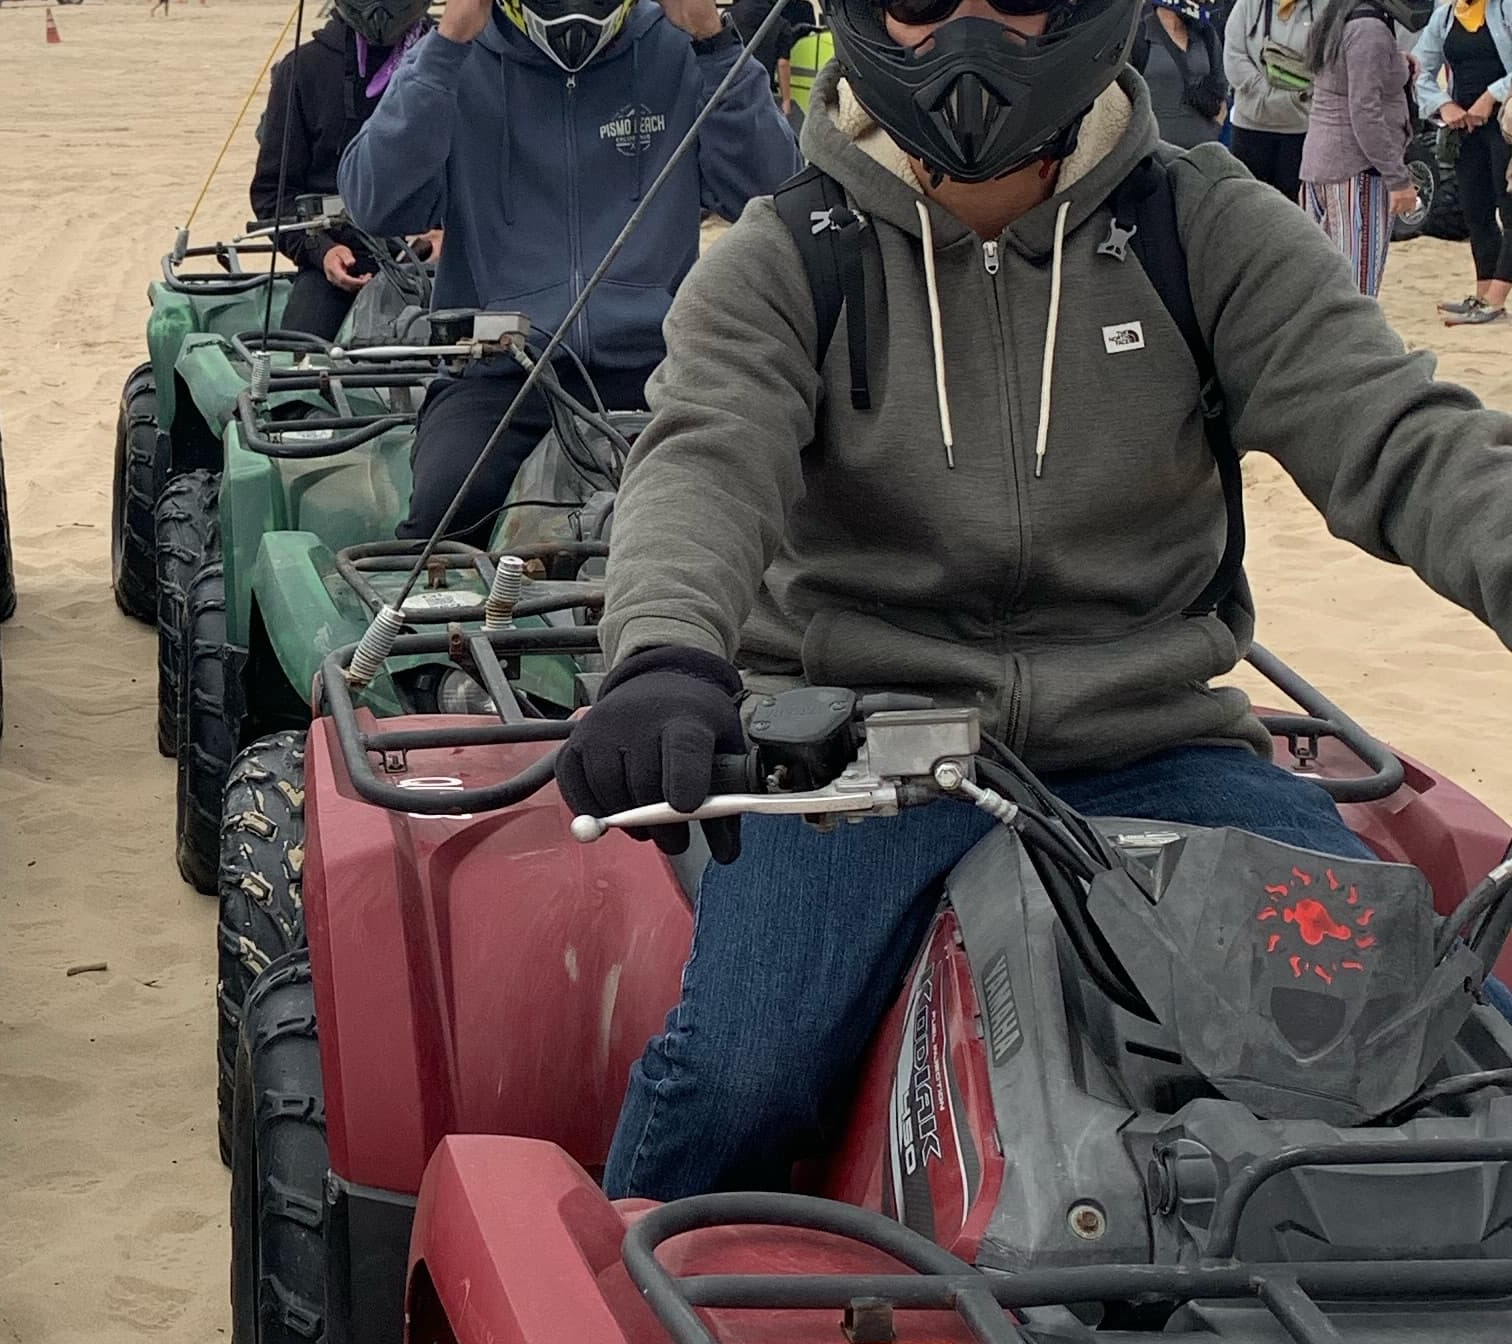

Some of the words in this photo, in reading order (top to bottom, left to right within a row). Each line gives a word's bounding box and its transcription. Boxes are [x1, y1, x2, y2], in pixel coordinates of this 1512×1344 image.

[600, 119, 631, 139] PISMO
[984, 955, 1021, 1061] YAMAHA
[914, 962, 943, 1167] KODIAK
[932, 1042, 945, 1111] INJECTION
[900, 1091, 917, 1175] 450
